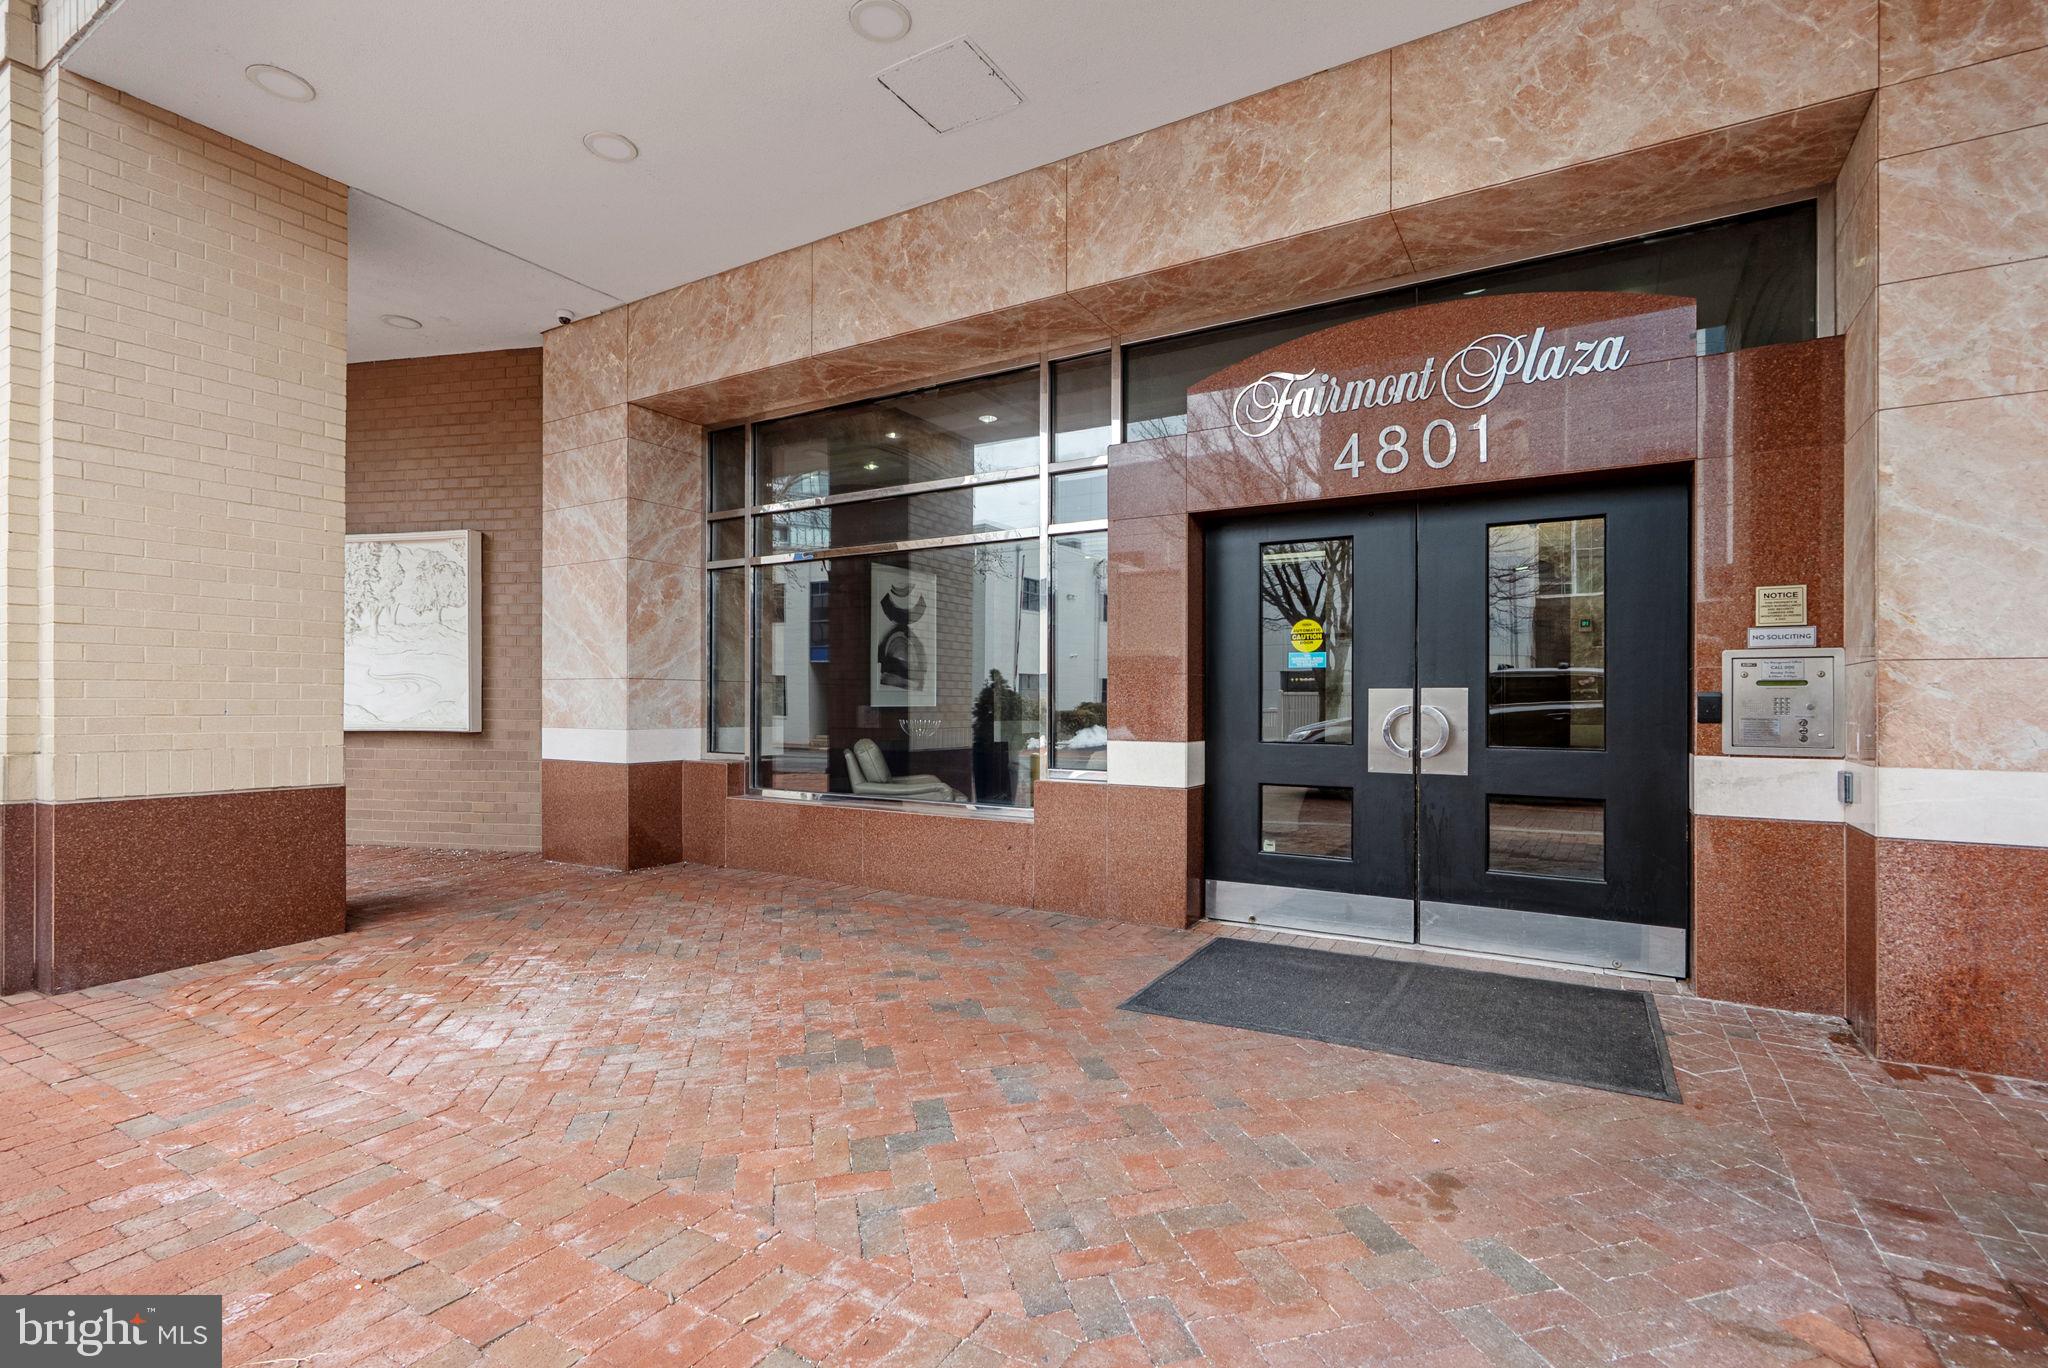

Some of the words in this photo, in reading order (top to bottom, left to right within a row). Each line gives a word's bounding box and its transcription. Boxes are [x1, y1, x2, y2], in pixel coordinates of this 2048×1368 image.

[1233, 357, 1437, 438] Fairmont
[1441, 326, 1631, 410] Plaza
[1333, 414, 1489, 479] 4801
[1763, 591, 1799, 599] NOTICE
